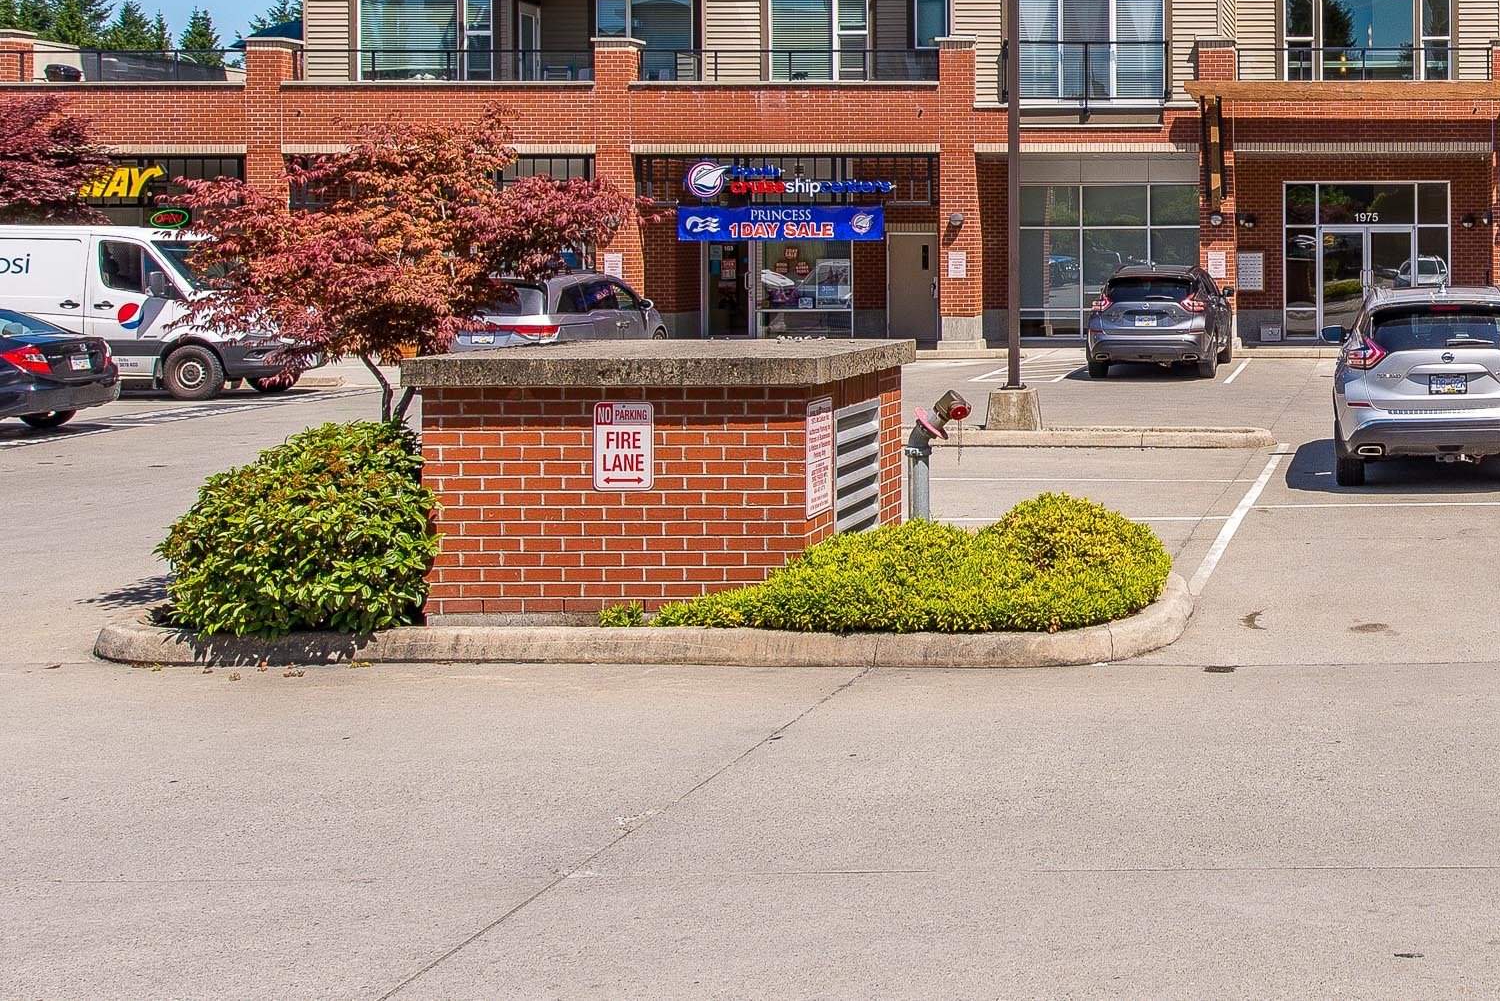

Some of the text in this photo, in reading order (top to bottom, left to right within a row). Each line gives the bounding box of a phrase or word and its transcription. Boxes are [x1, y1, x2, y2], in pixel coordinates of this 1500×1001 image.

[730, 178, 891, 198] cruiseshipcenters
[154, 212, 184, 224] OPEN
[750, 209, 812, 221] PRINCESS
[1354, 212, 1379, 223] 1975
[729, 222, 835, 238] 1 DAY SALE
[597, 406, 648, 423] NO PARKING
[606, 431, 642, 450] FIRE
[602, 453, 645, 472] LANE
